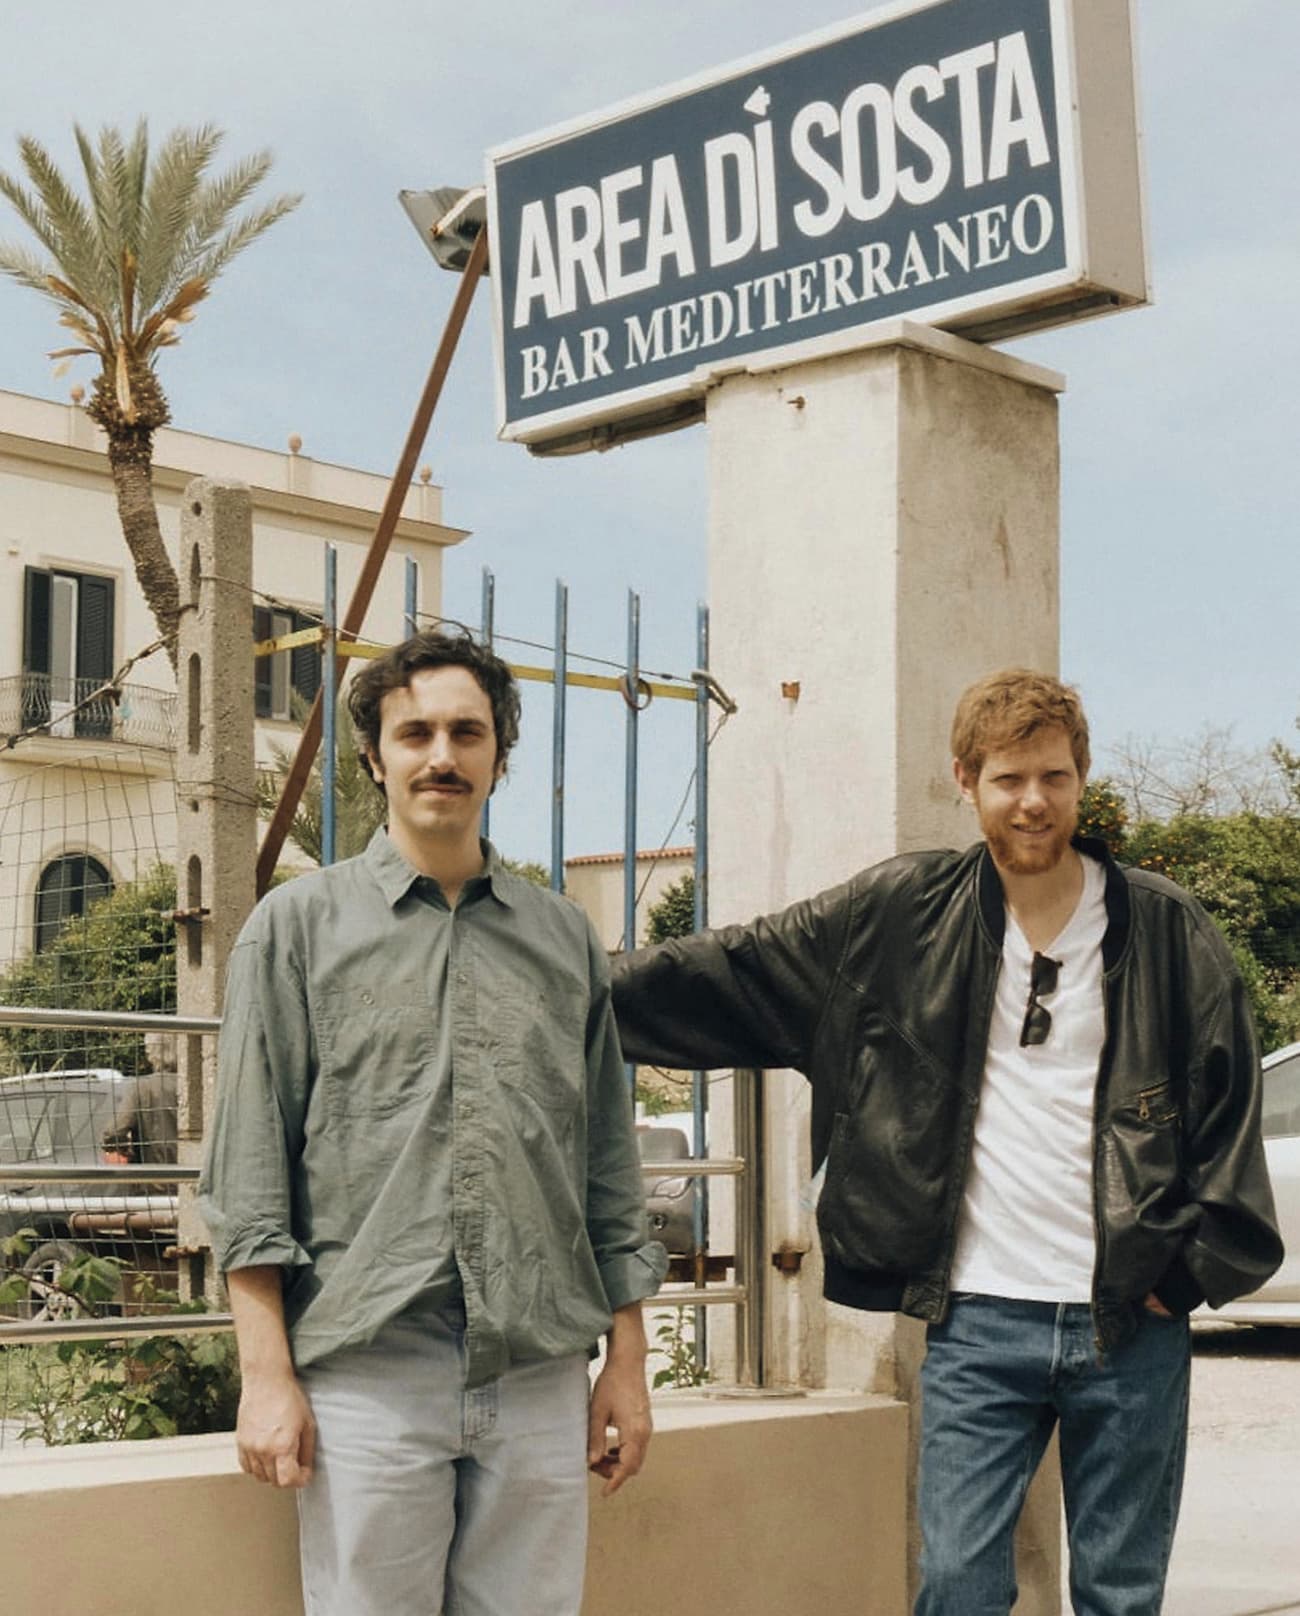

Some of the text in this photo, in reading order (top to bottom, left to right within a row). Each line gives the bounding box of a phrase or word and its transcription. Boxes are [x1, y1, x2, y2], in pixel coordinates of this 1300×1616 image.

[513, 153, 697, 329] AREA
[790, 30, 1051, 238] SOSTA
[520, 193, 1054, 400] BAR MEDITERRANEO
